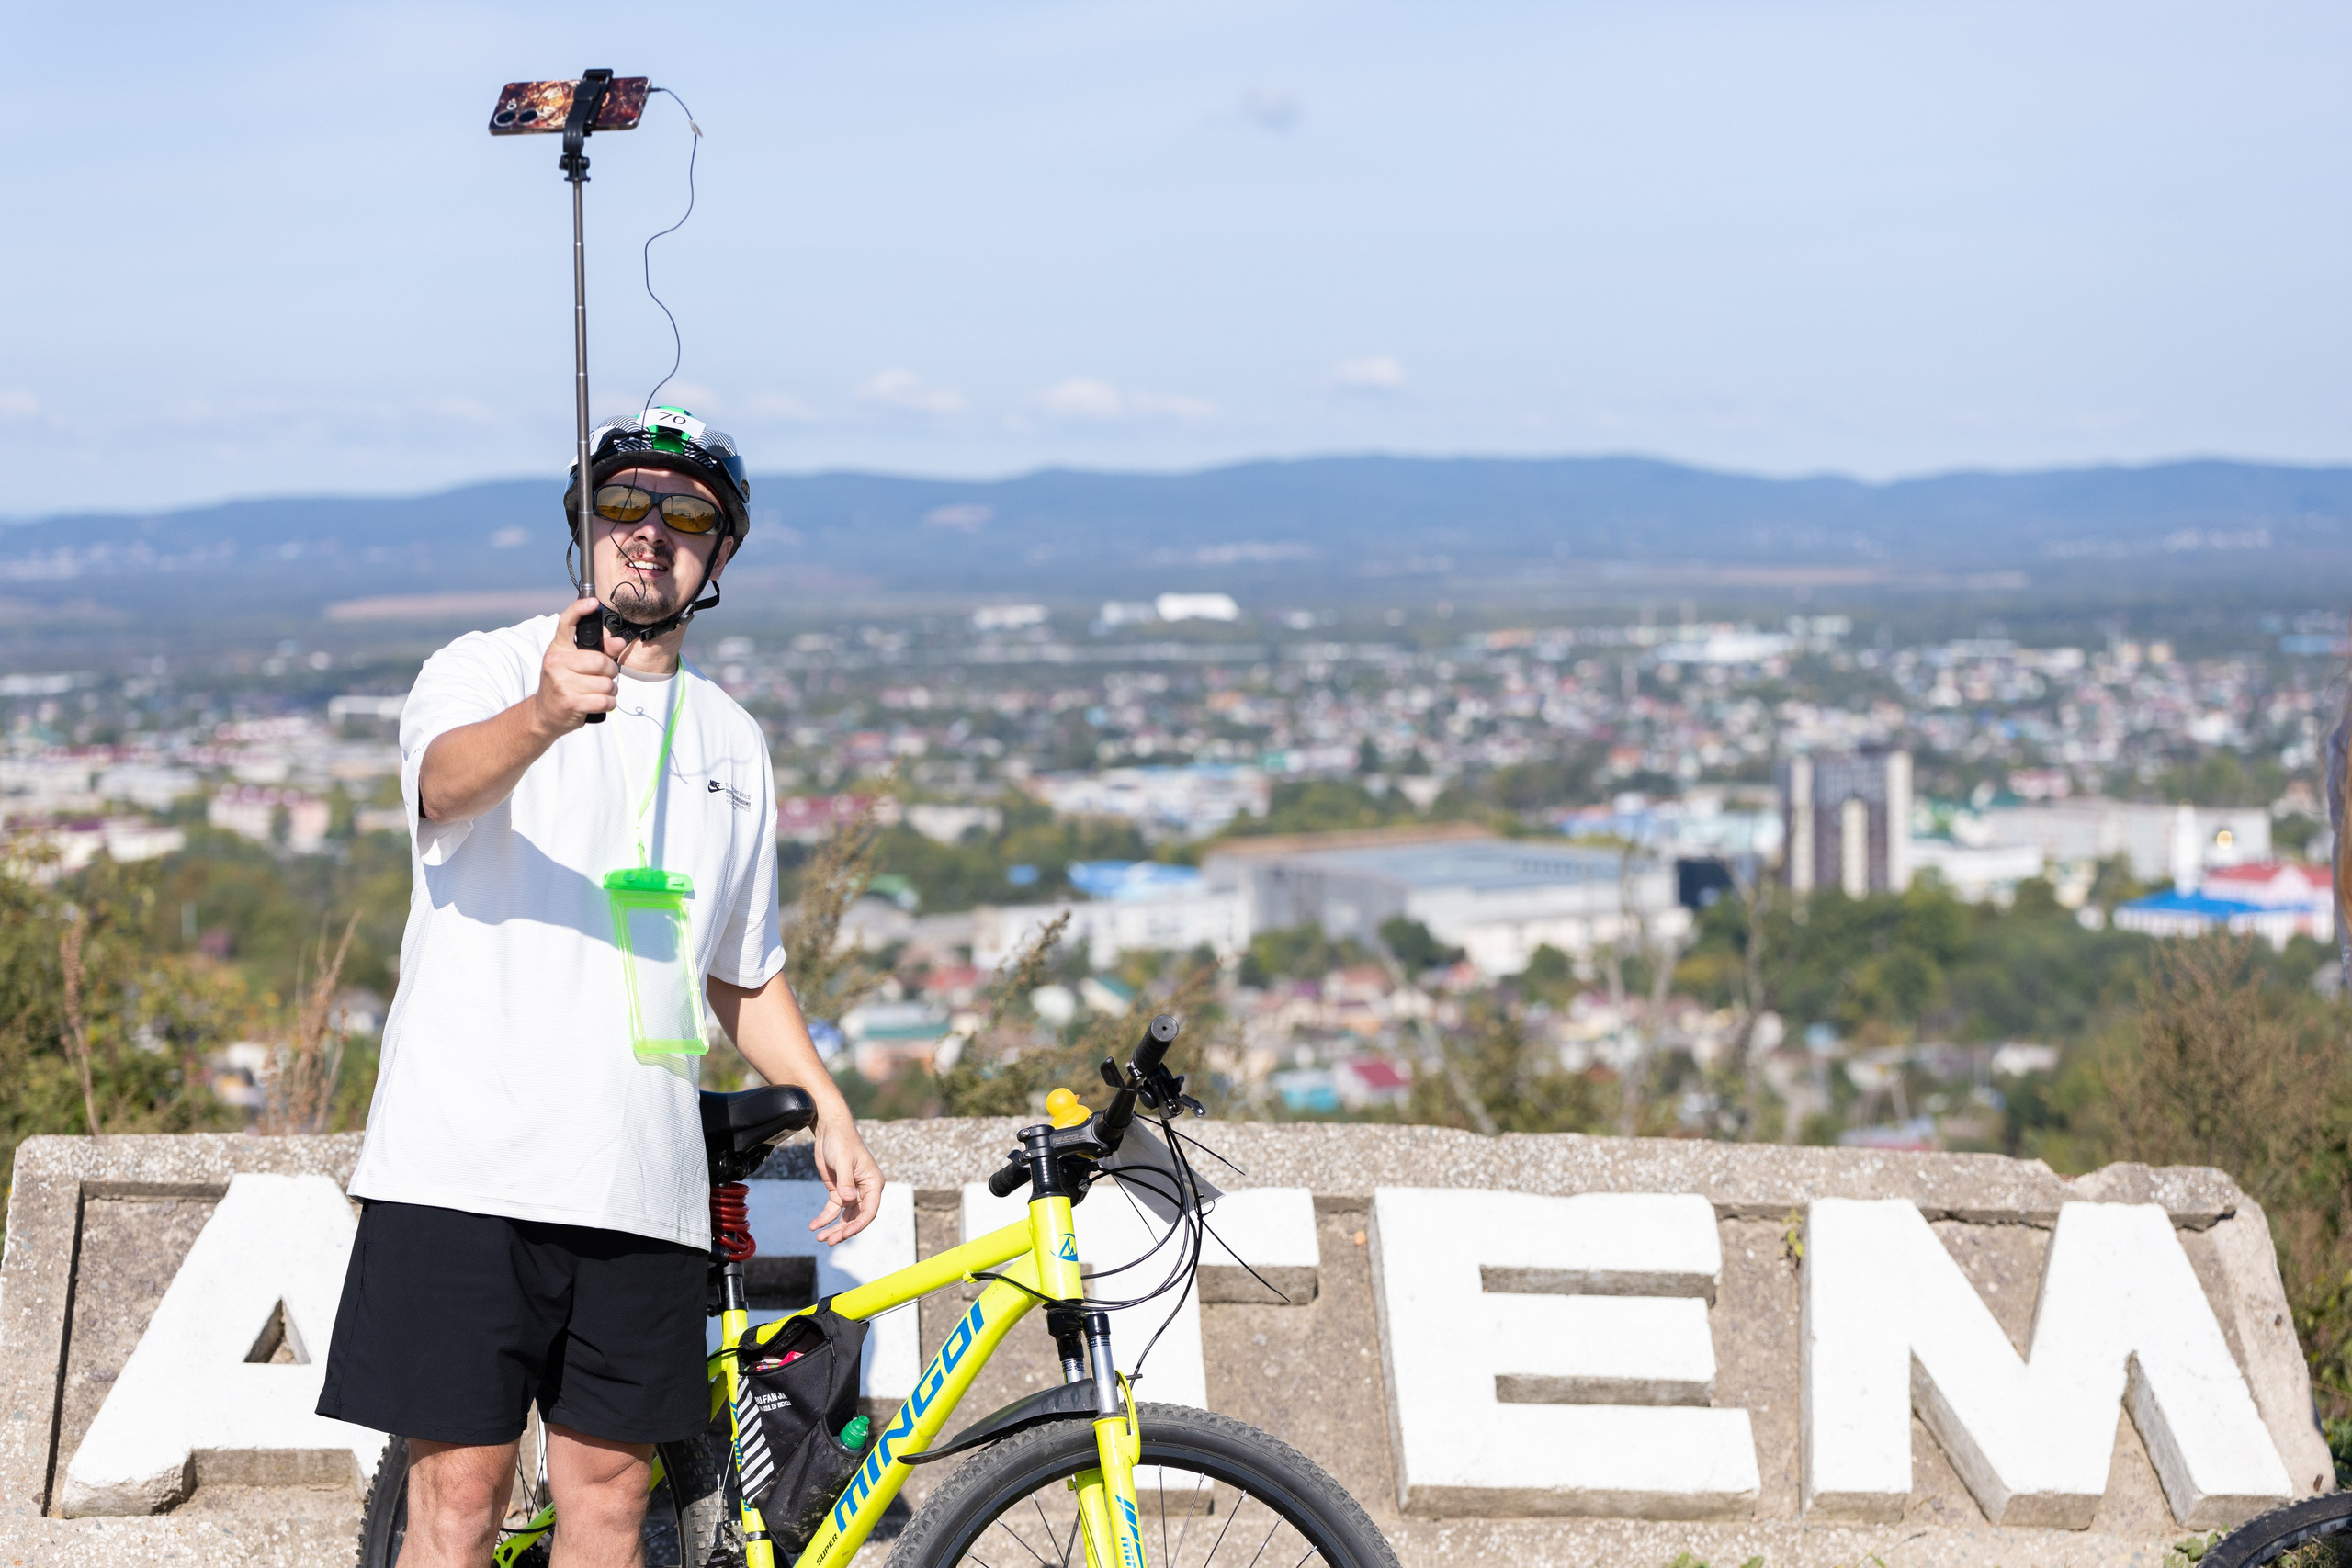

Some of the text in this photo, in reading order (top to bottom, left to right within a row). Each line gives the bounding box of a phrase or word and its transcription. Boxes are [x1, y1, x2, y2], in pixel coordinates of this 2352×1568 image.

[659, 412, 686, 426] 70
[763, 1393, 777, 1404] FAN
[816, 1533, 838, 1565] SUPER
